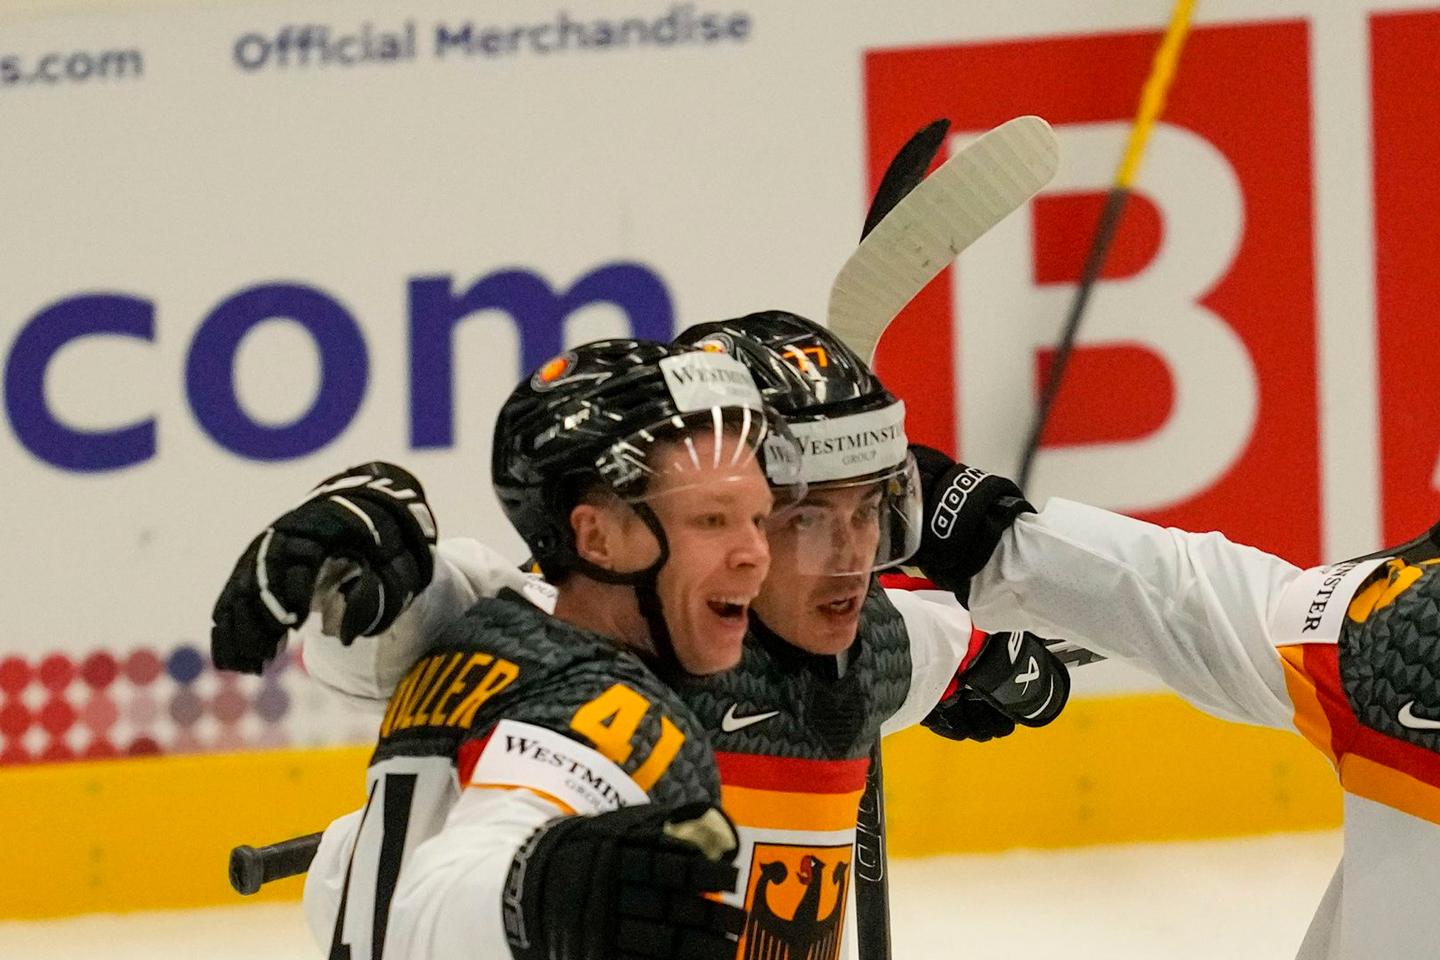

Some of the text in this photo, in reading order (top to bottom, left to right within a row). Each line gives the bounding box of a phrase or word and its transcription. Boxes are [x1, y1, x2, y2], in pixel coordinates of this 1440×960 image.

[232, 2, 752, 73] Official Merchandise
[3, 260, 678, 475] com
[569, 683, 686, 793] 41
